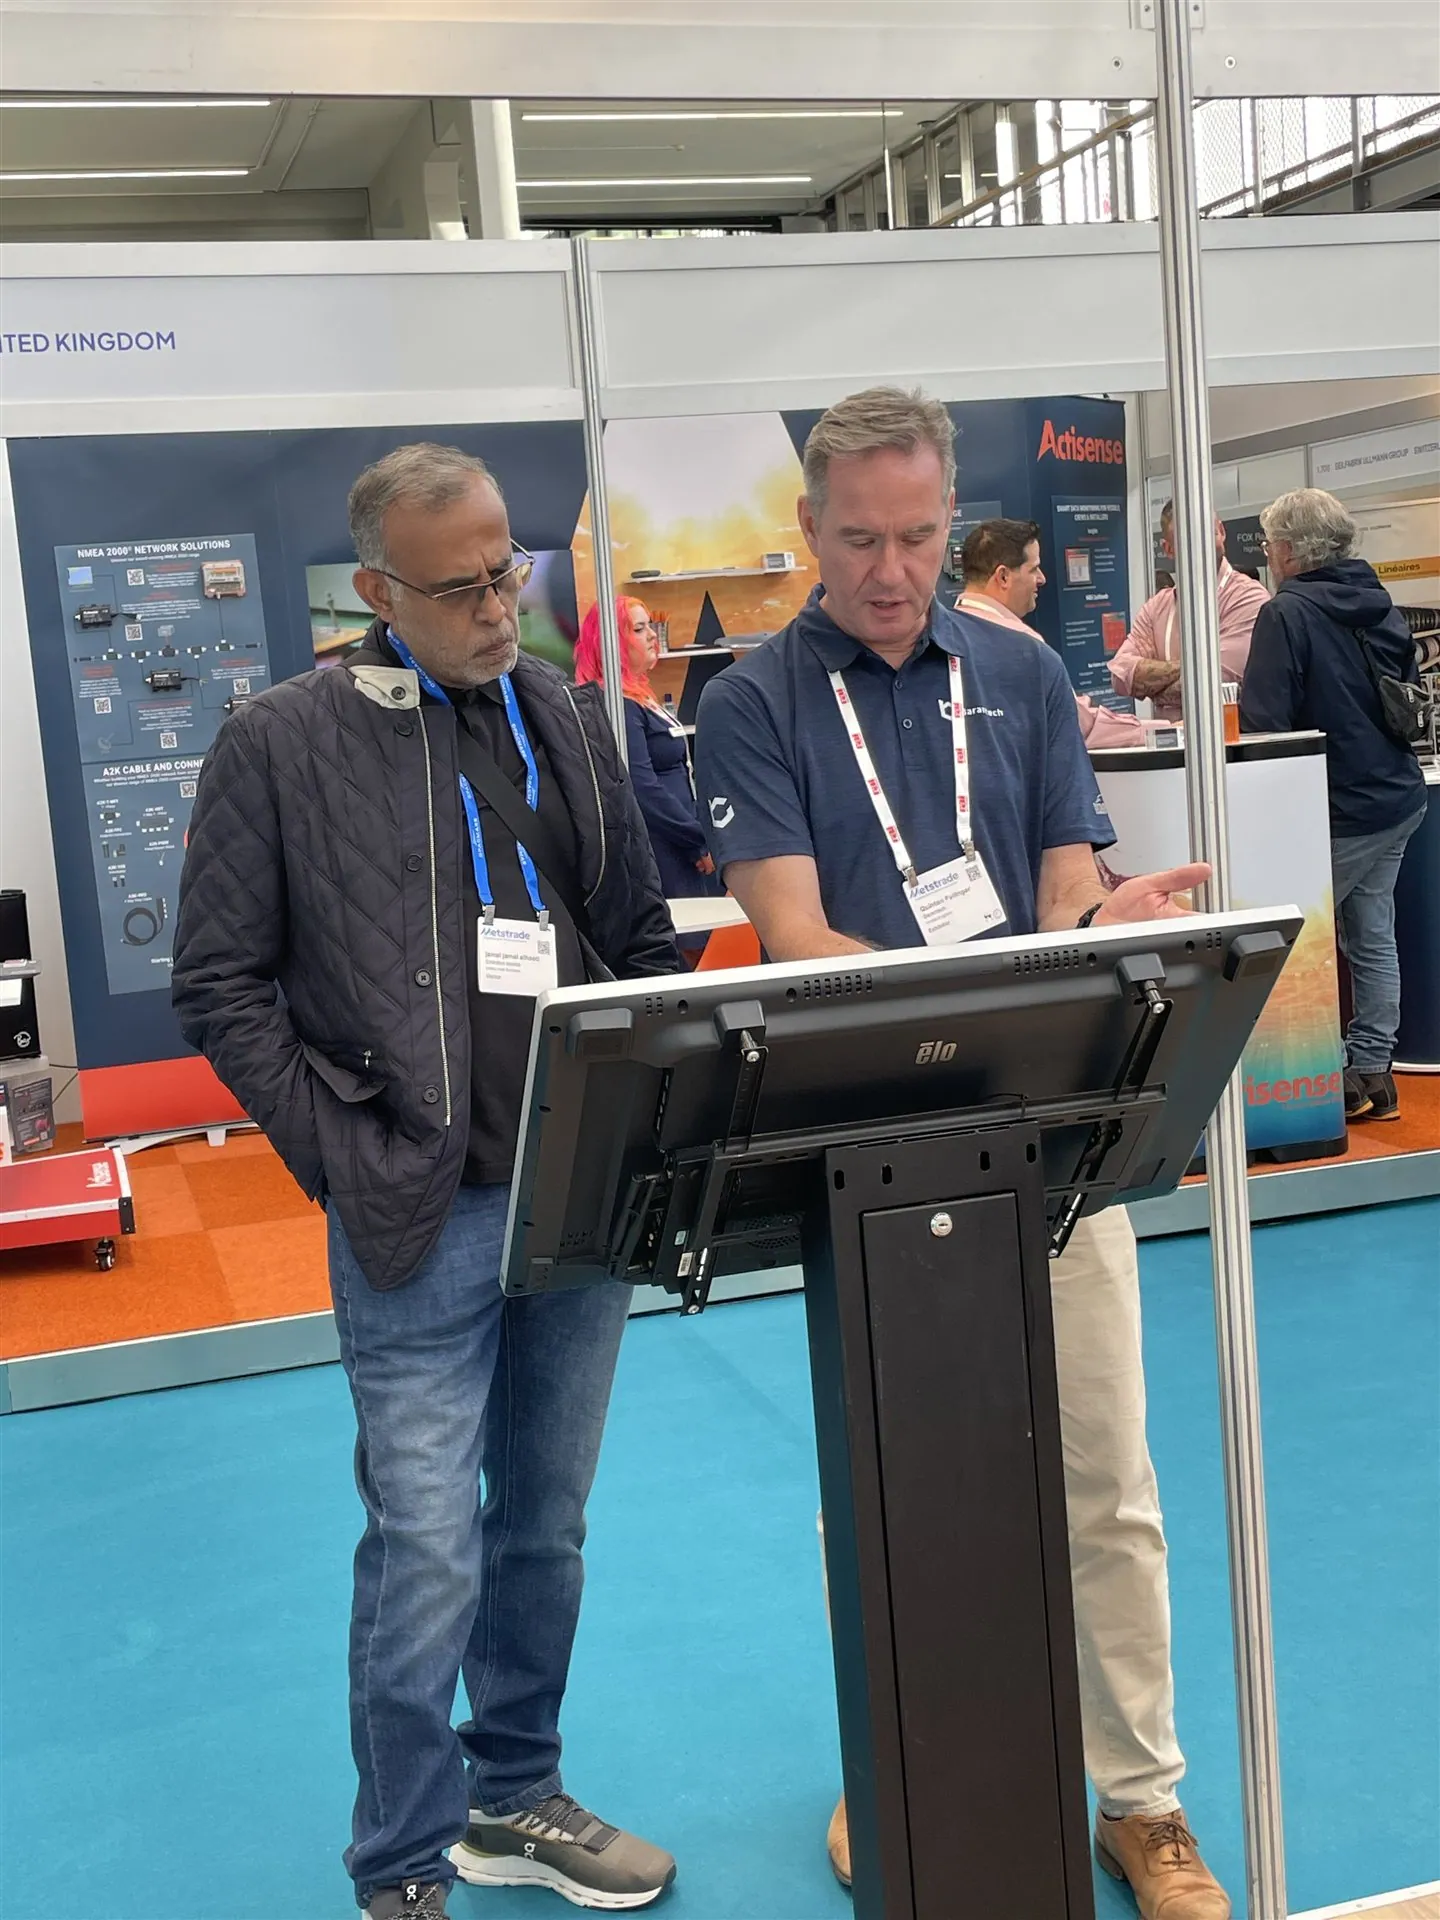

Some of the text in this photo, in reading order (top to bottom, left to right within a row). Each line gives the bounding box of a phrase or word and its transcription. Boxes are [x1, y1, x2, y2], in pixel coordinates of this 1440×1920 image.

[55, 331, 176, 352] KINGDOM
[1037, 419, 1123, 465] Actisense
[1236, 532, 1254, 542] FOX
[77, 549, 105, 559] NMEA
[134, 542, 179, 555] NETWORK
[180, 539, 231, 551] SOLUTIONS
[1379, 563, 1421, 574] Linéaires
[102, 767, 121, 777] A2K
[122, 763, 152, 774] CABLE
[153, 762, 173, 772] AND
[910, 871, 960, 899] Metstrade
[480, 927, 531, 940] Metstrade
[1243, 1071, 1341, 1106] isense
